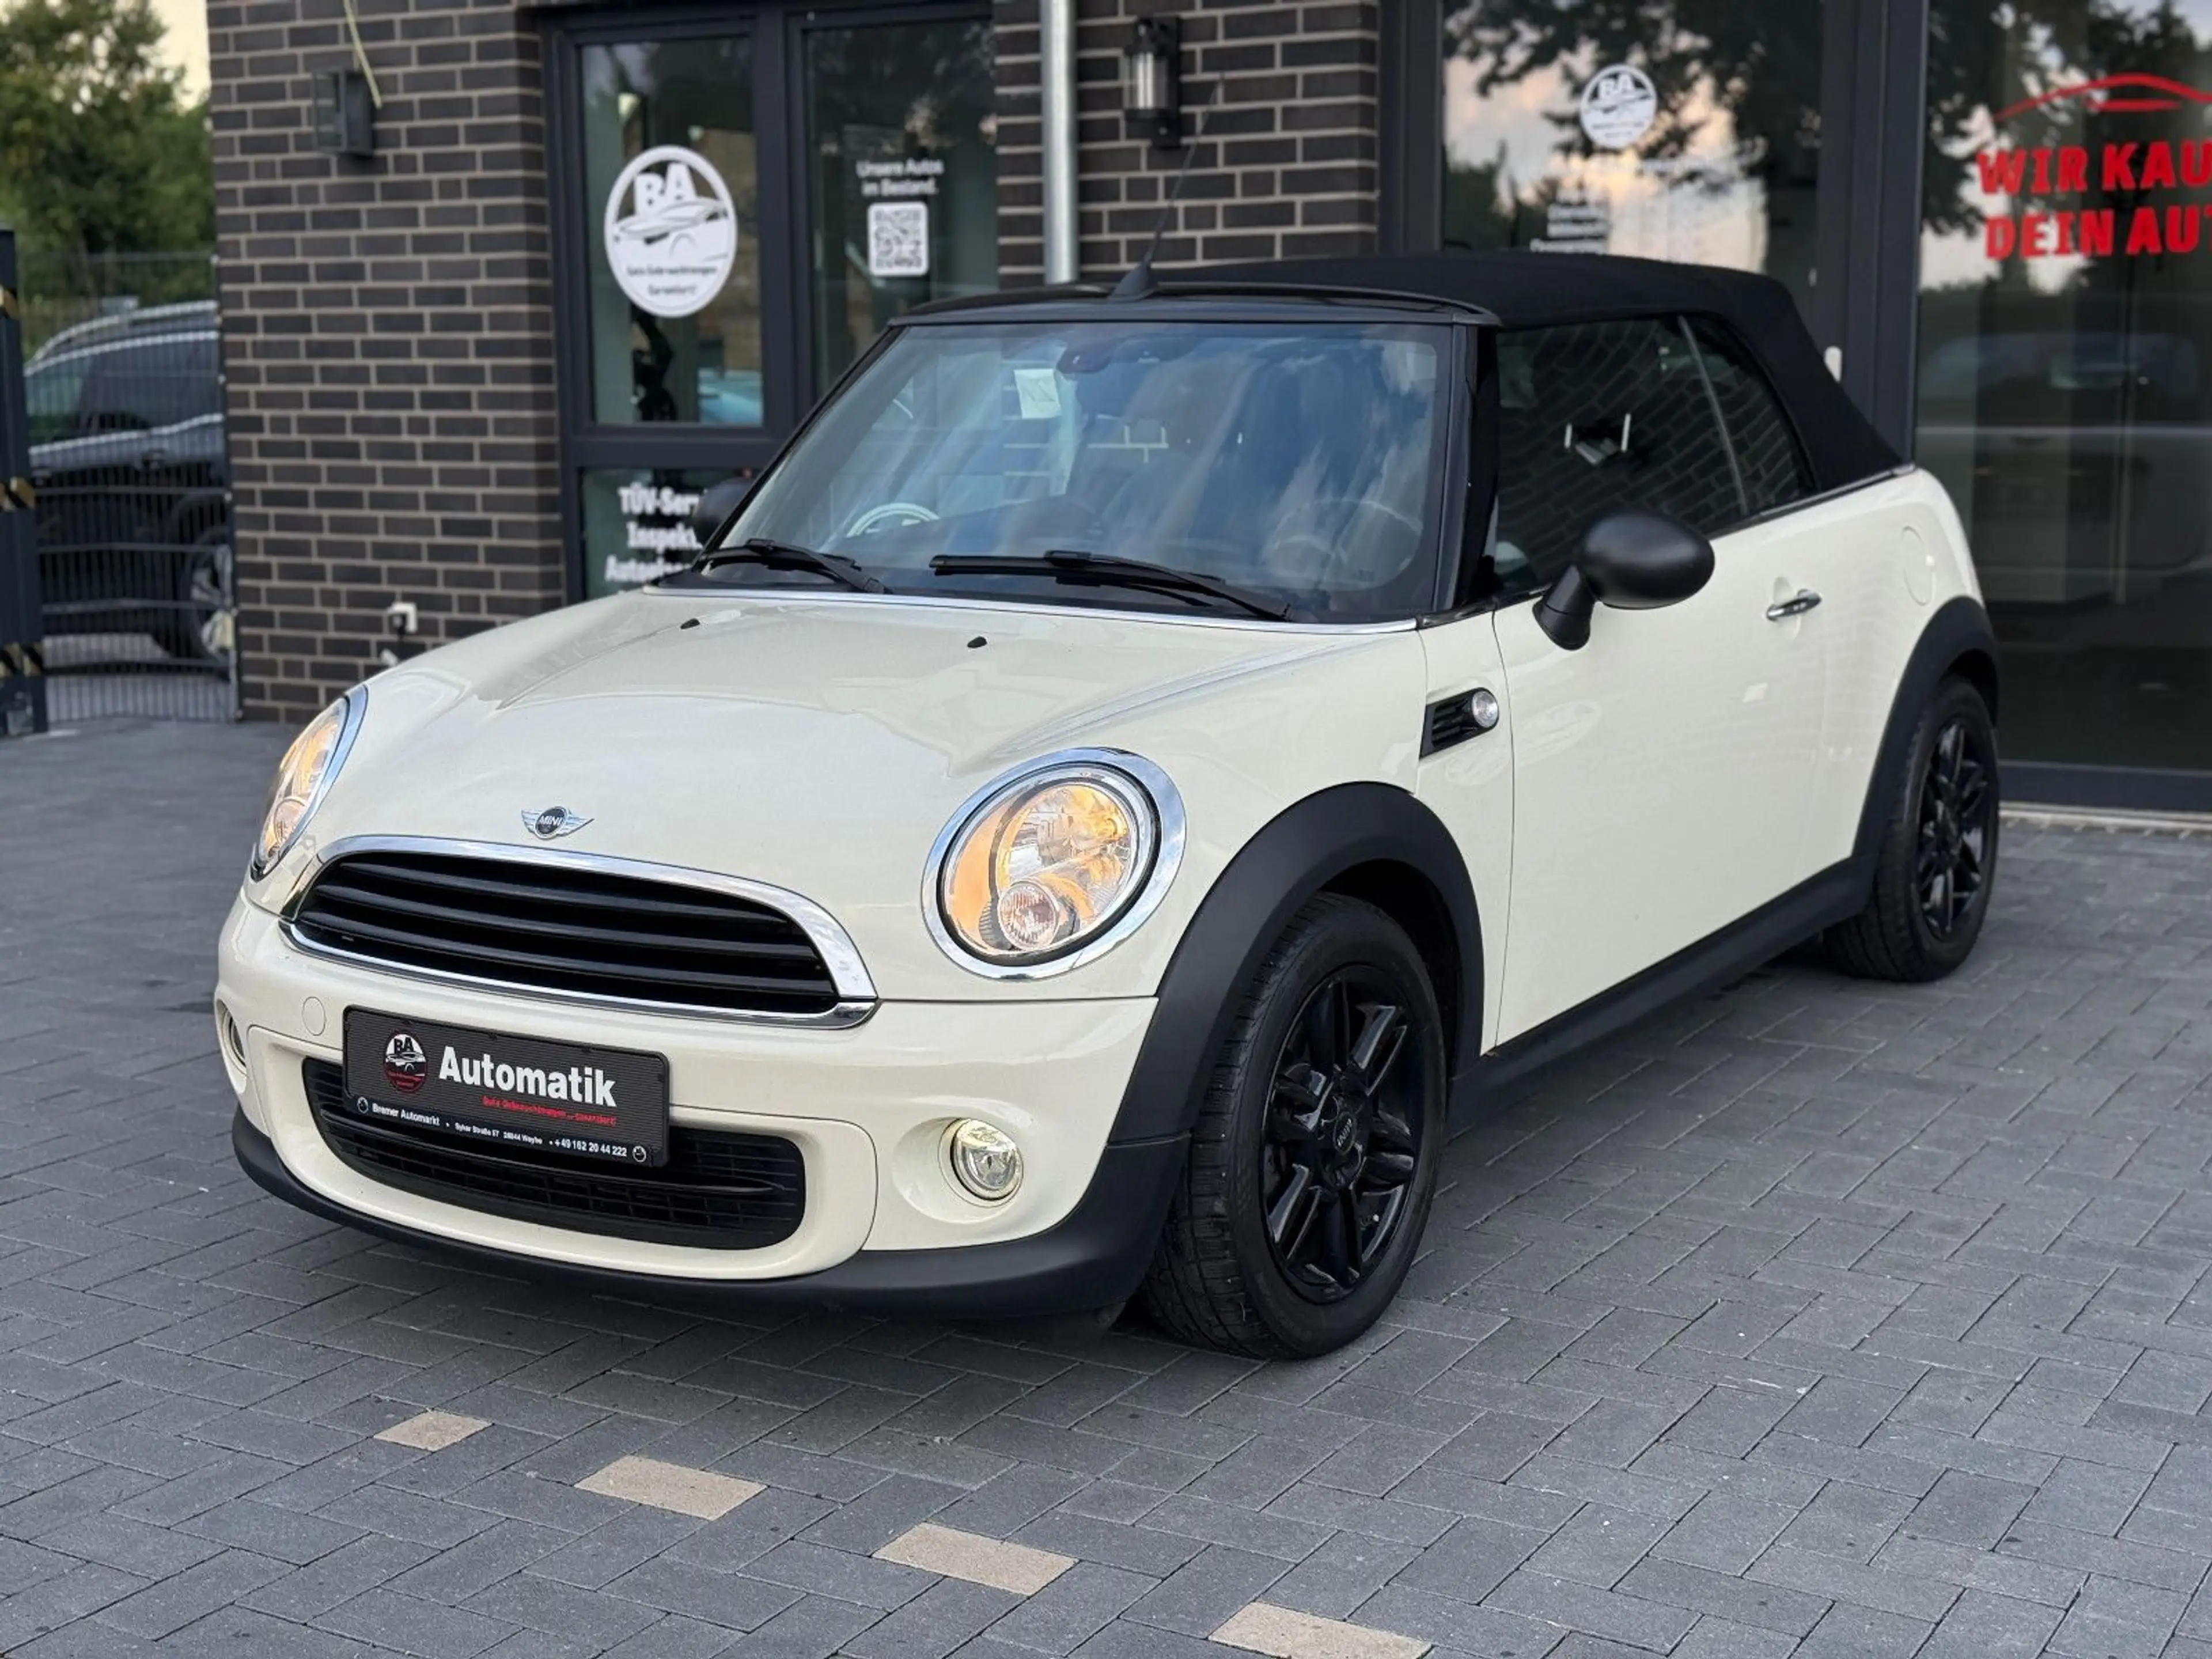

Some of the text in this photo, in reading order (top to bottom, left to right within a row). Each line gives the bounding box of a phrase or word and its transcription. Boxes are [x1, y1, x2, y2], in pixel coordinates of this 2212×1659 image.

[634, 162, 696, 215] BA
[1976, 141, 2212, 195] WIR KAU
[1984, 204, 2212, 260] DEIN AU
[539, 815, 563, 827] MINI
[393, 1037, 414, 1055] BA
[439, 1045, 618, 1108] Automatik
[372, 1103, 399, 1117] Bremer
[400, 1108, 441, 1126] Automarkt
[588, 1141, 599, 1153] 20
[600, 1143, 611, 1155] 44
[612, 1145, 627, 1157] 222
